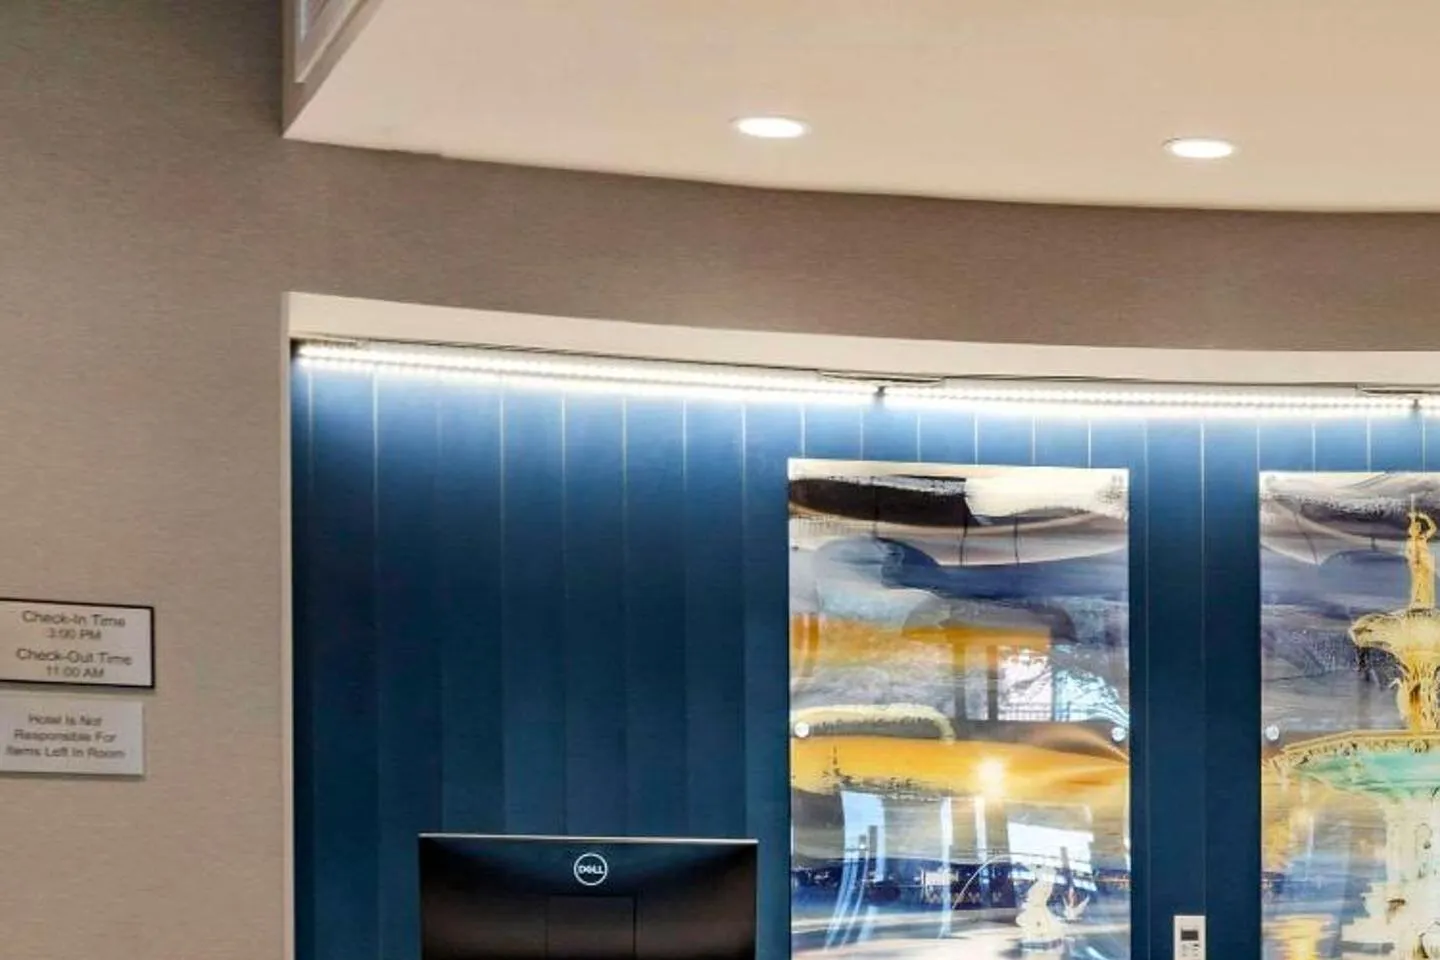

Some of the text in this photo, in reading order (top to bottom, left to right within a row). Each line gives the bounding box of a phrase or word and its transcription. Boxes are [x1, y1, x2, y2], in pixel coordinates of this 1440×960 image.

[22, 610, 126, 628] Check-In Time
[80, 628, 102, 640] PM
[15, 648, 133, 666] Check-Out Time
[83, 667, 104, 678] AM
